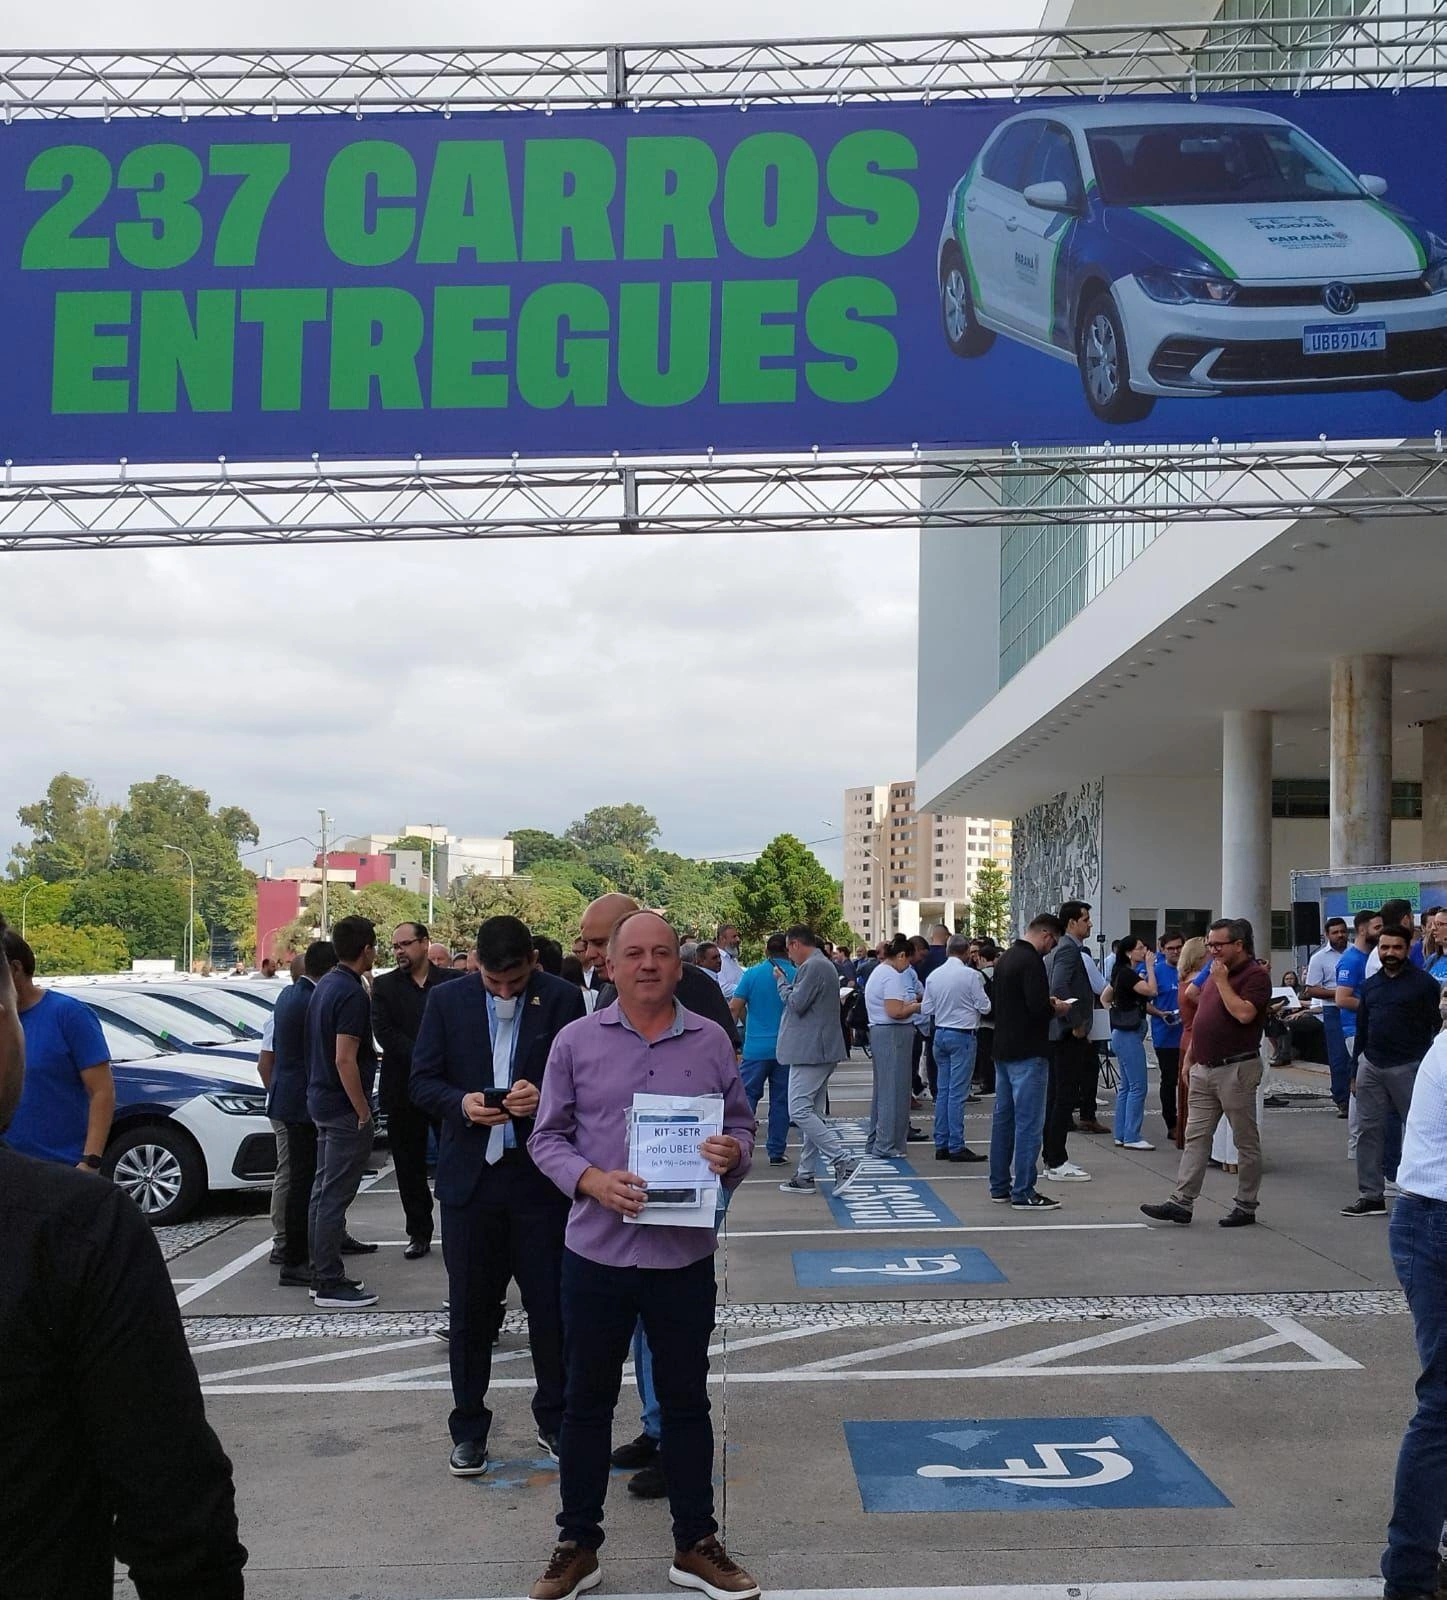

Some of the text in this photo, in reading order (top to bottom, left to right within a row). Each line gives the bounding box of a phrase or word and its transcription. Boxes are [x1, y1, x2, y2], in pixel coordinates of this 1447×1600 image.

[20, 128, 920, 271] 237 CARROS
[51, 275, 899, 415] ENTREGUES
[1312, 331, 1378, 351] UBB9D41
[654, 1127, 670, 1137] KIT
[677, 1127, 701, 1137] SETR
[646, 1144, 667, 1154] Polo
